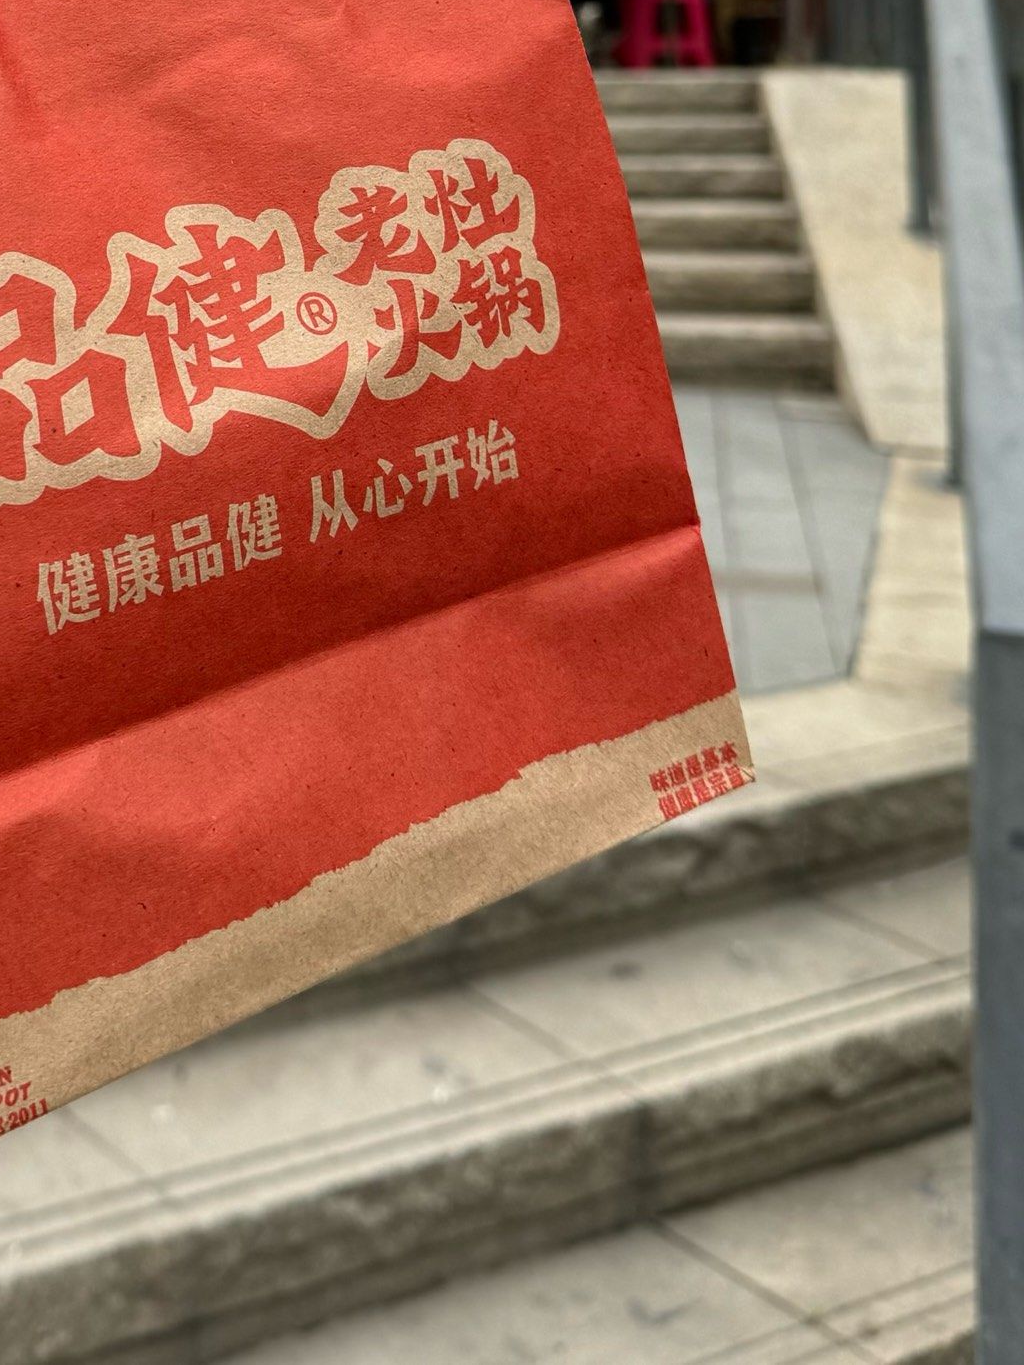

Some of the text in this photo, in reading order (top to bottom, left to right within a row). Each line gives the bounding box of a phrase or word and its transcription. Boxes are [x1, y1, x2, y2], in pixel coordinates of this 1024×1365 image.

[333, 157, 520, 286] 老灶
[373, 245, 546, 379] 火锅
[36, 420, 520, 635] 健康品健 从心开始
[9, 1098, 49, 1129] 2011
